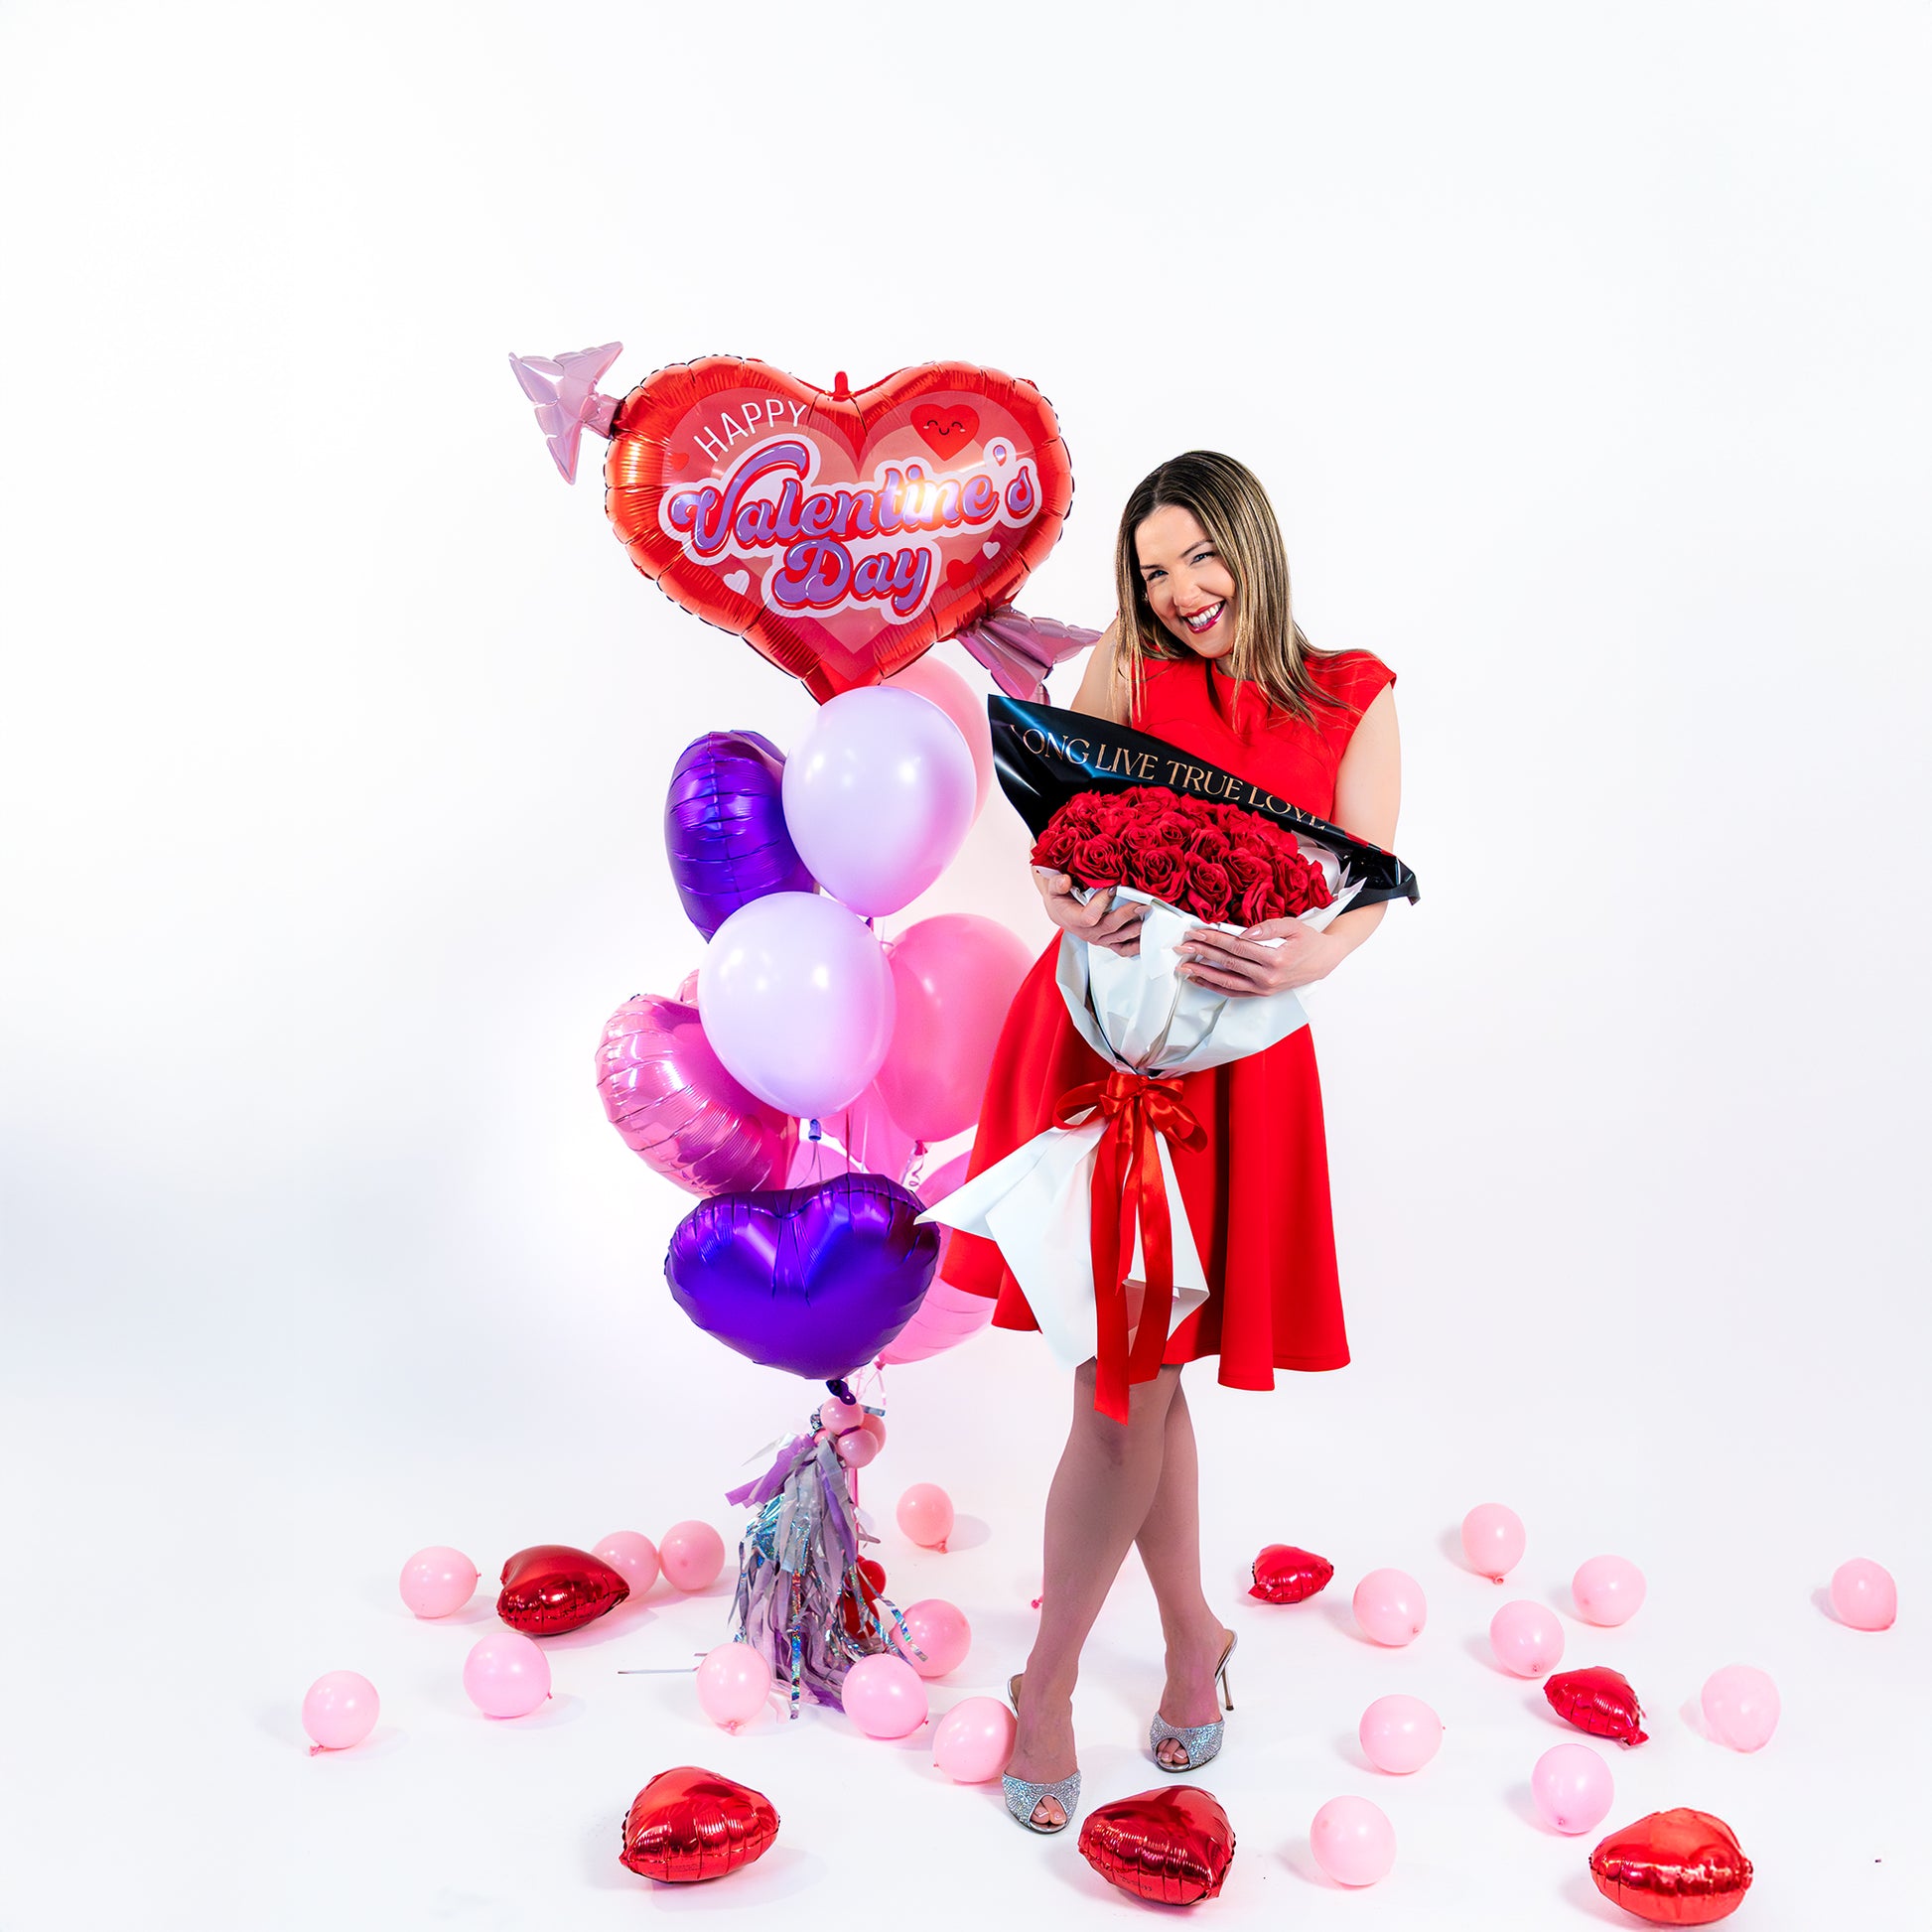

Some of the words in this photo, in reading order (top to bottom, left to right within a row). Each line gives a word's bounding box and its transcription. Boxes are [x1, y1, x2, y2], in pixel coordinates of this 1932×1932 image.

[693, 398, 808, 463] HAPPY
[667, 440, 1035, 556] Valentine's
[771, 537, 931, 617] Day
[1095, 744, 1159, 780] LIVE
[1167, 760, 1244, 801] TRUE
